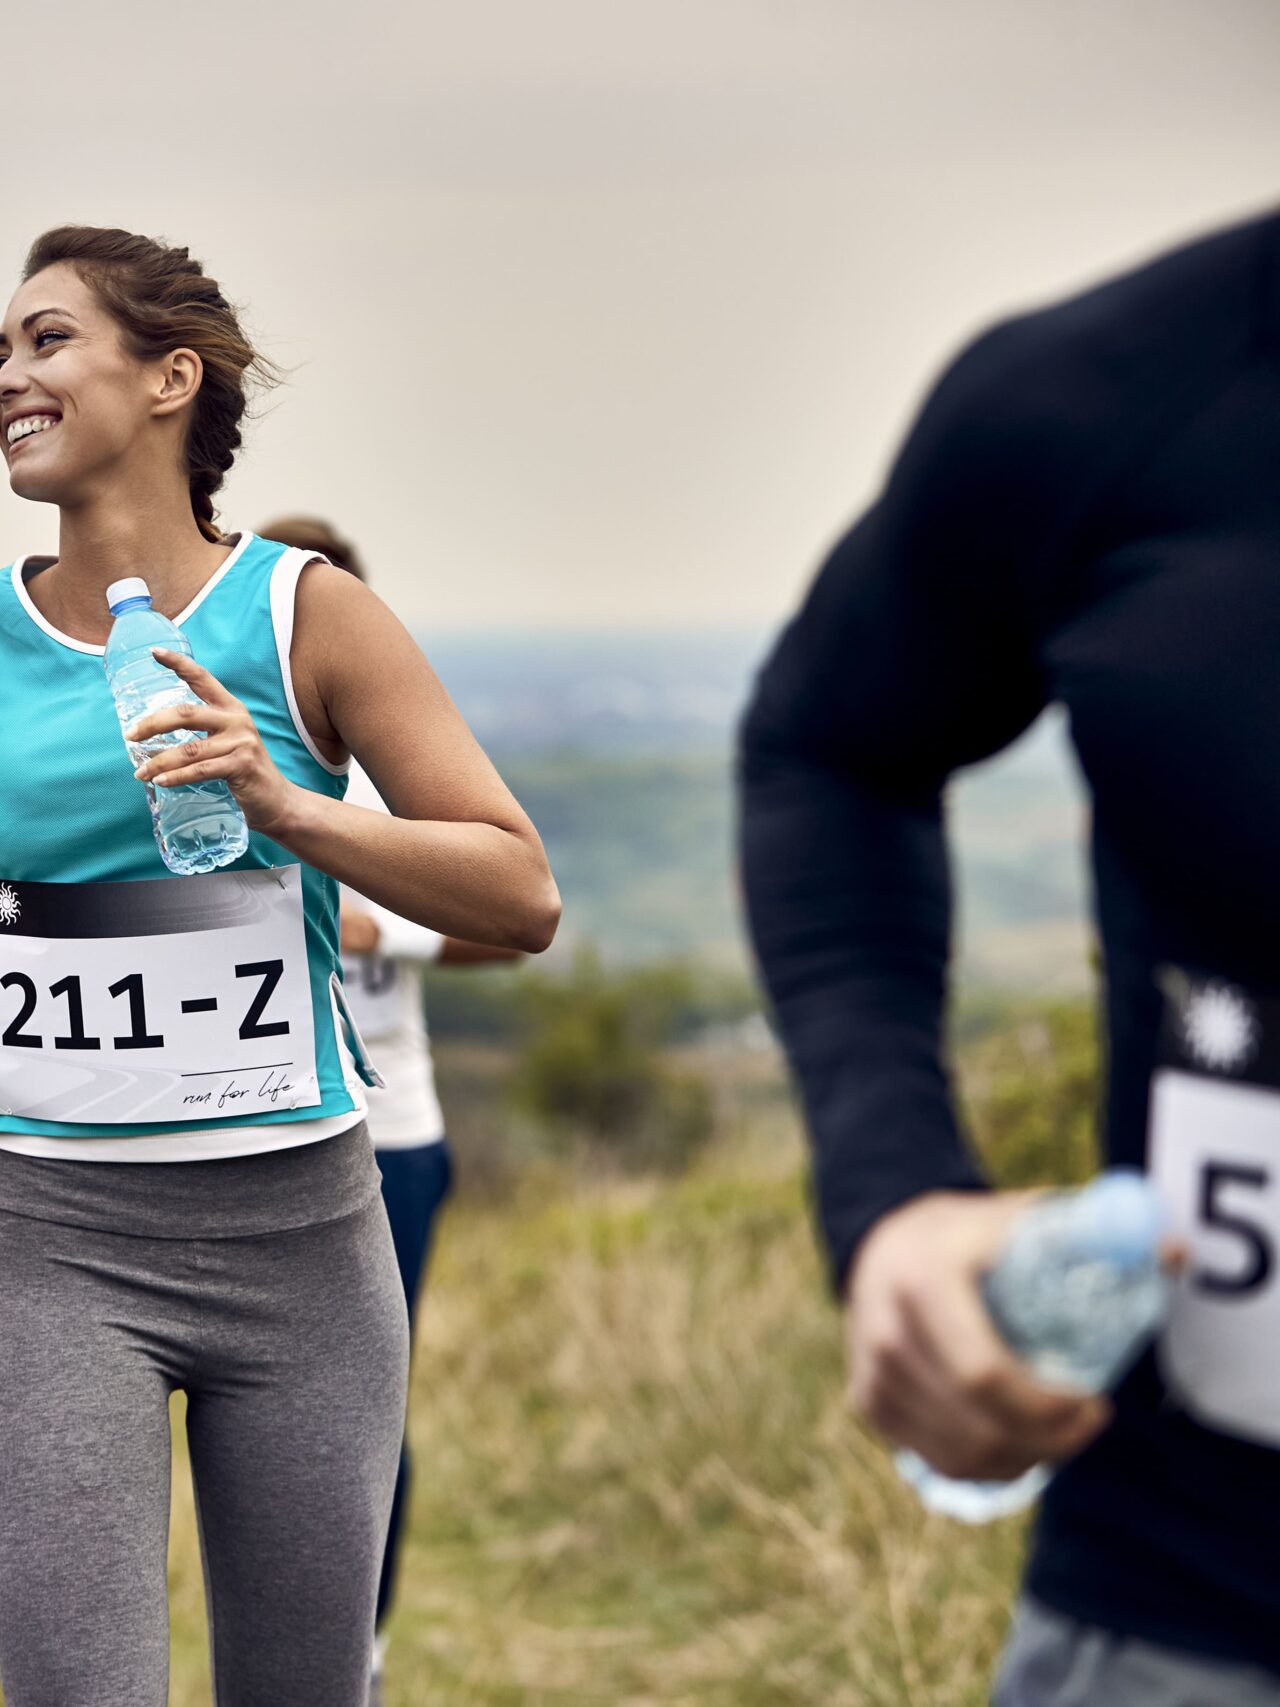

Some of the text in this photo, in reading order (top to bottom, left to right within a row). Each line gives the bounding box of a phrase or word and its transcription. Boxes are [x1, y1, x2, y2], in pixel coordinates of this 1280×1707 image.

[0, 959, 290, 1050] 211-Z
[183, 1071, 295, 1108] run for life
